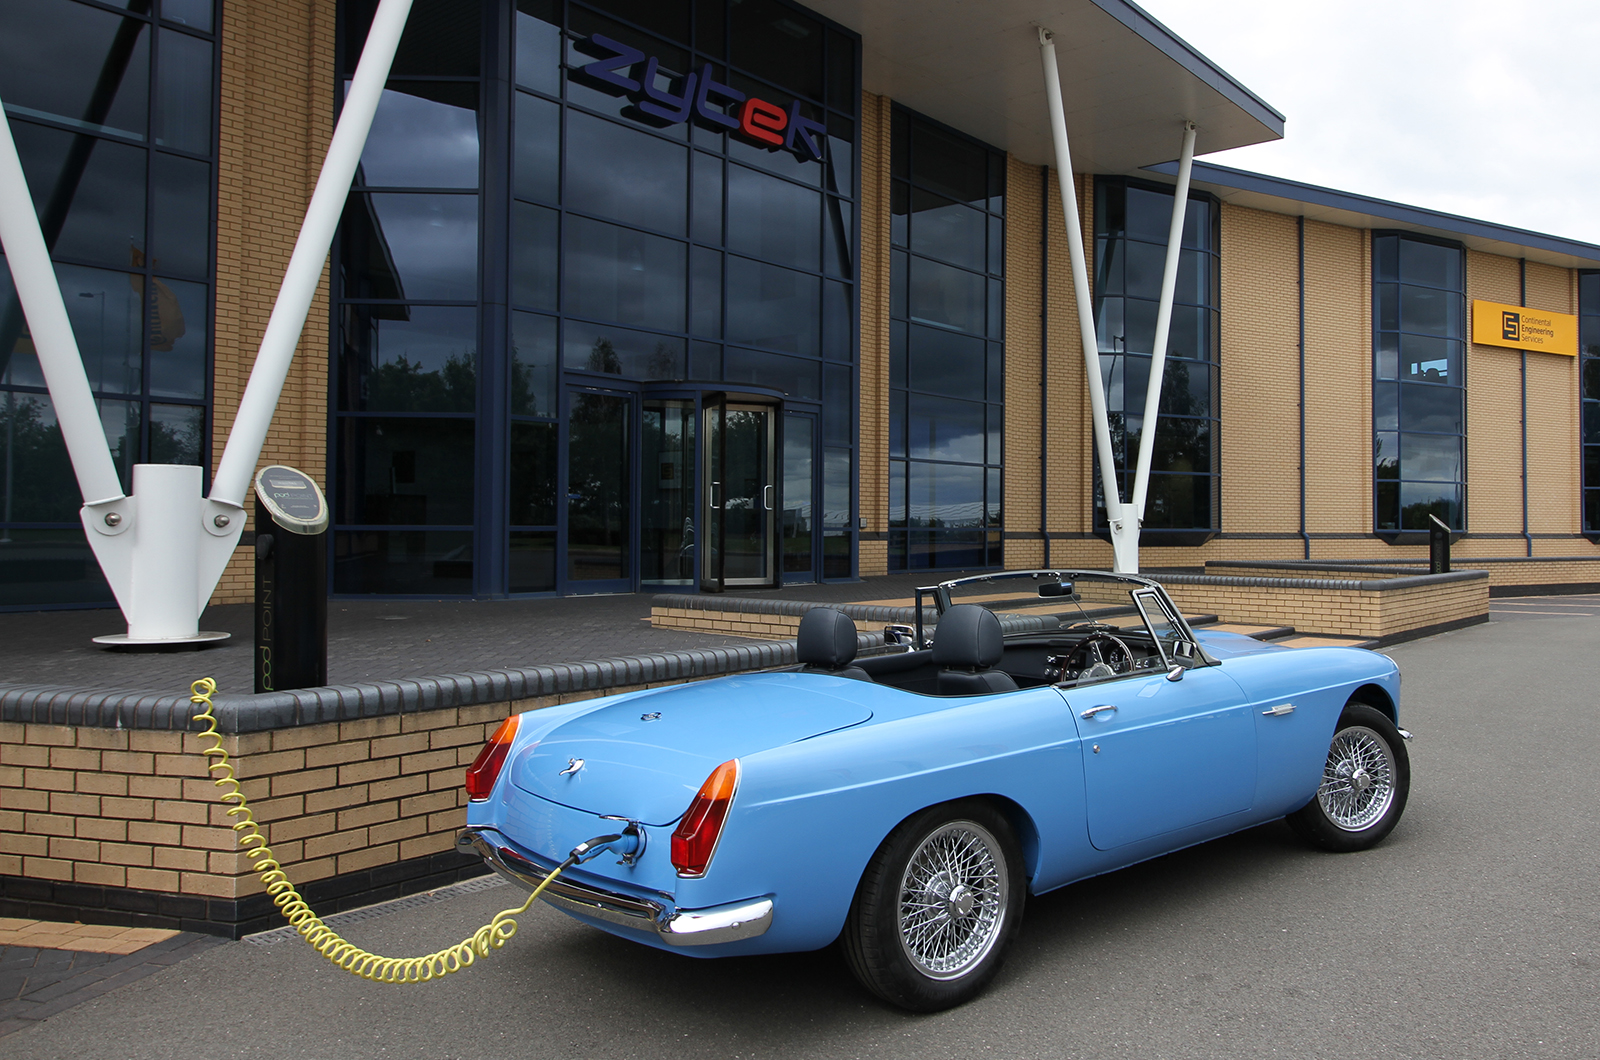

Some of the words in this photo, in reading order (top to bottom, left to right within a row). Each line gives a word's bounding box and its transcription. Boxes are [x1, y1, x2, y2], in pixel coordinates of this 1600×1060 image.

[584, 33, 827, 160] zytek
[1521, 315, 1551, 327] Continental
[1521, 324, 1554, 338] Engineering
[1521, 333, 1544, 344] Services
[263, 575, 272, 641] POINT
[259, 645, 274, 692] pod
